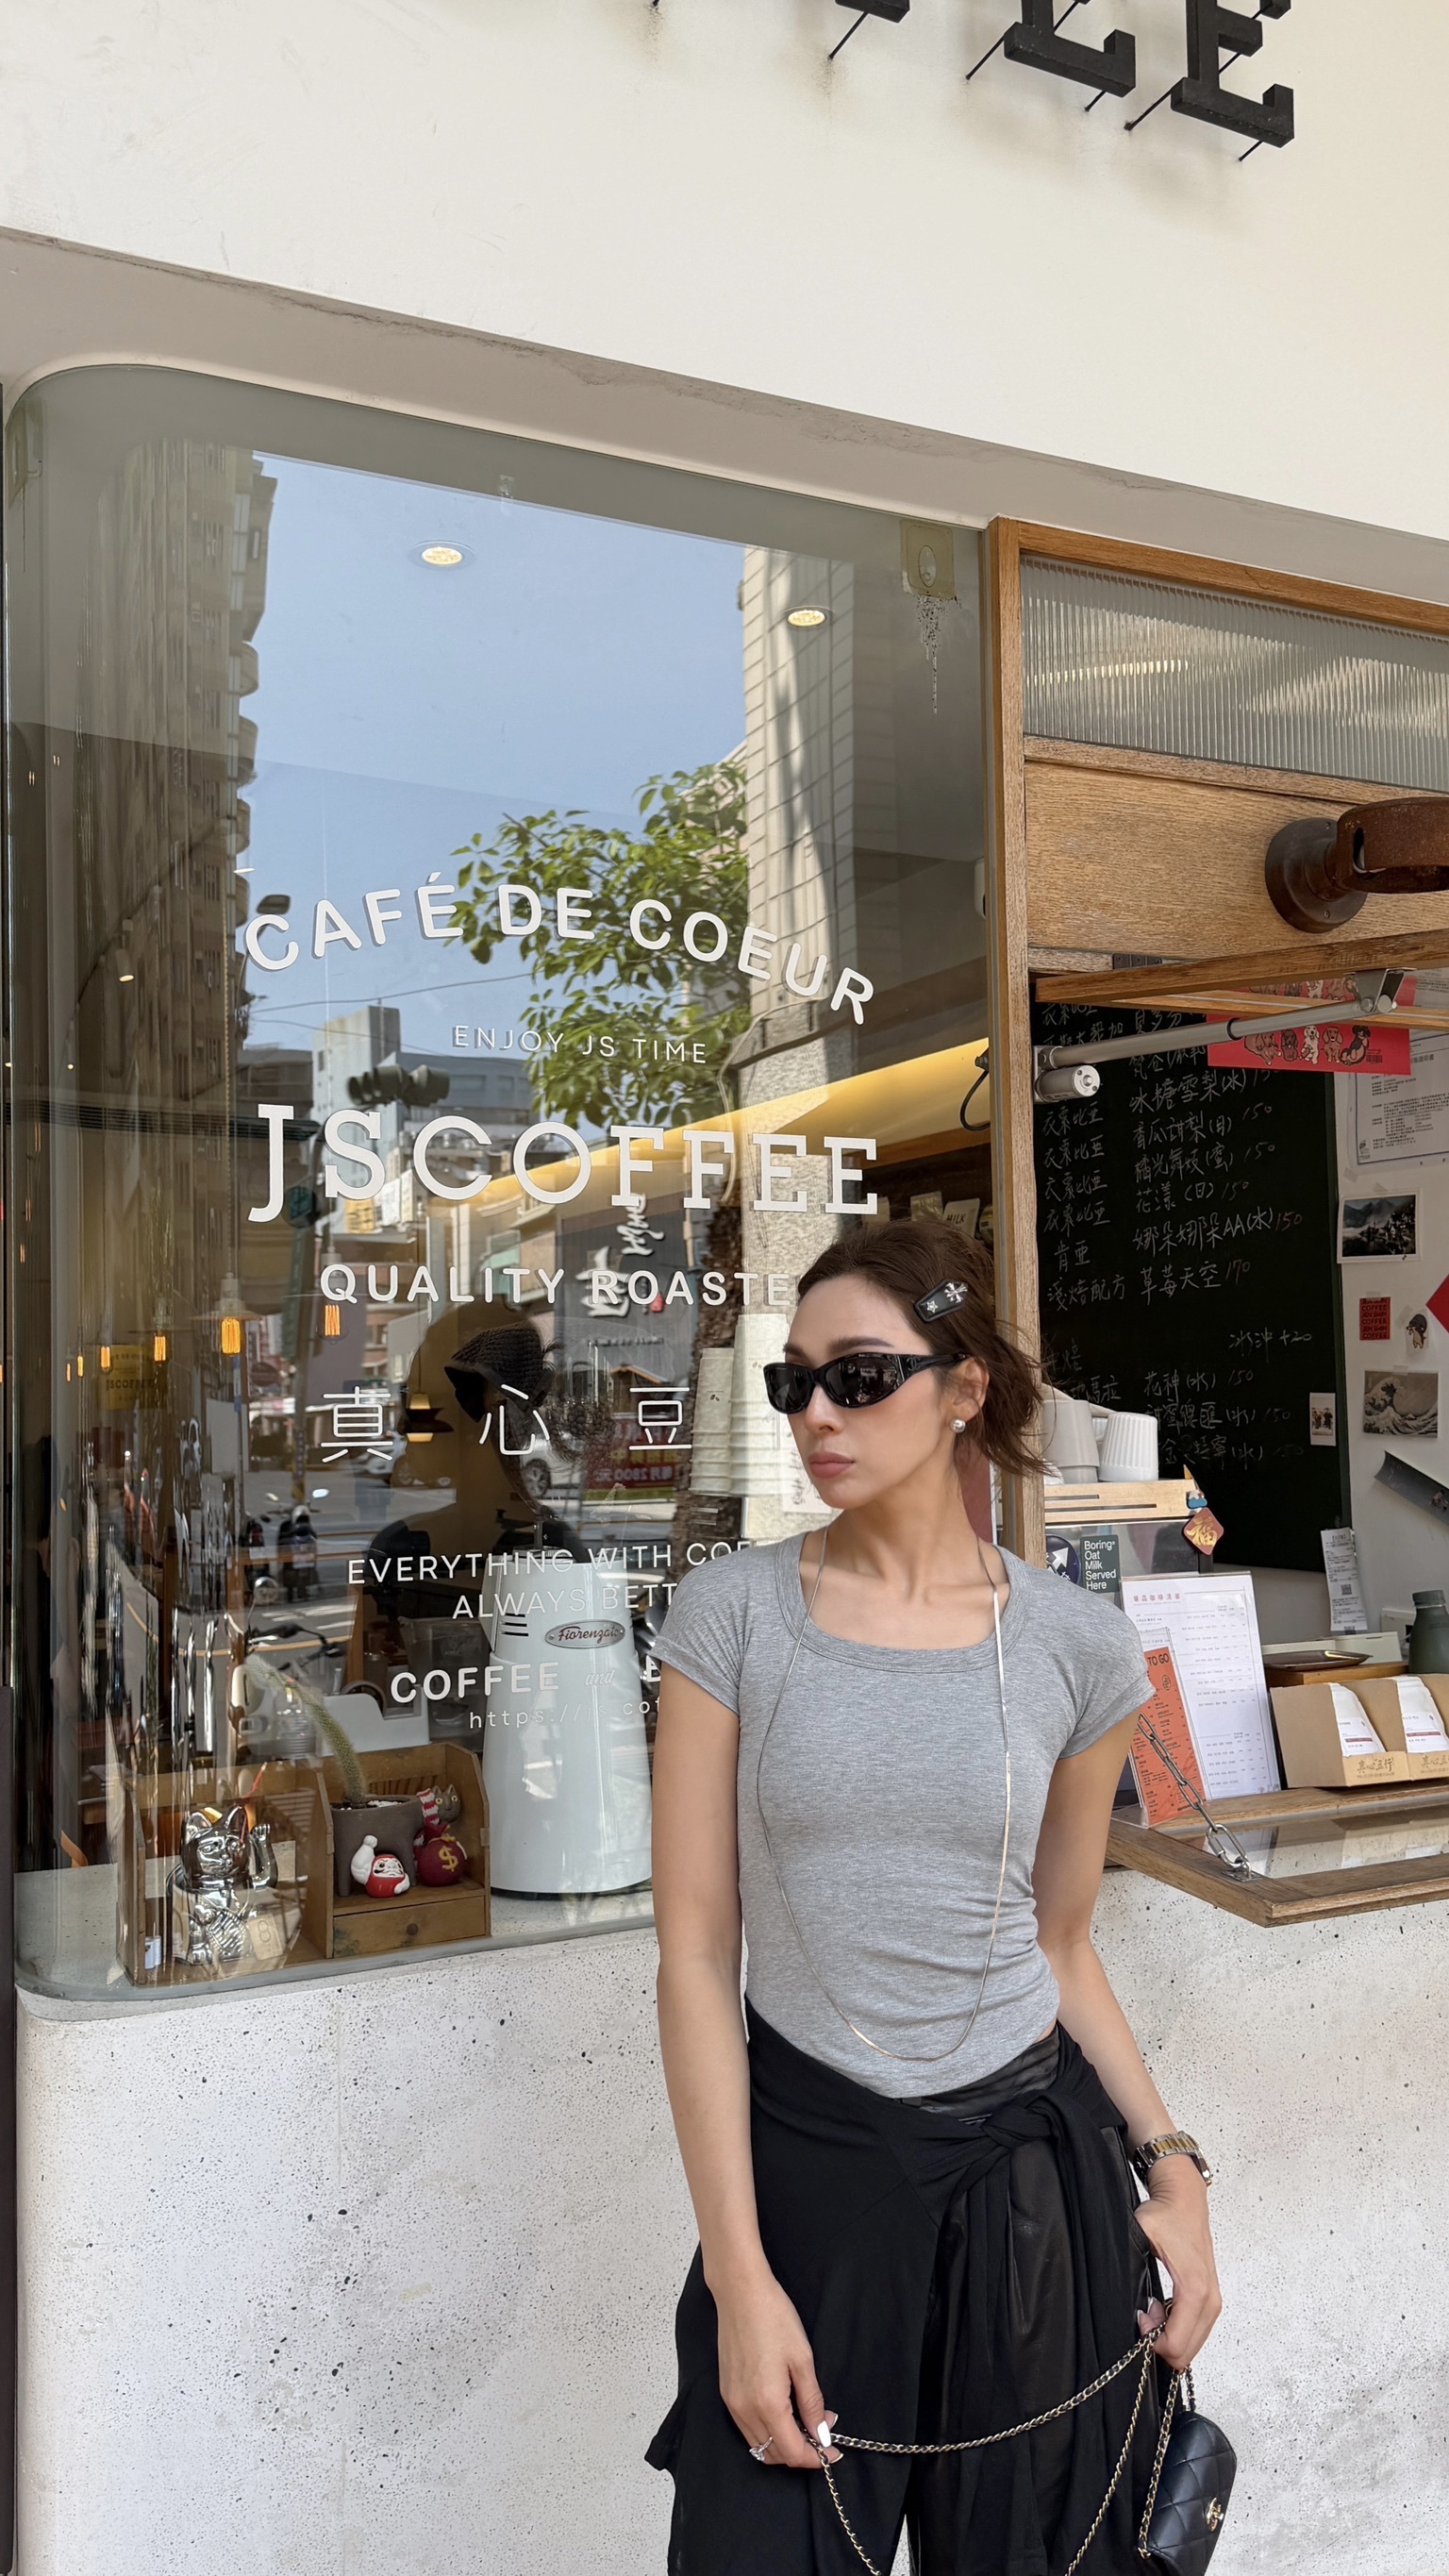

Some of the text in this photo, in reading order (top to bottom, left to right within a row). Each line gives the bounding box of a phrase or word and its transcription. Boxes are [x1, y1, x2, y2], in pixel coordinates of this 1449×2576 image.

[245, 872, 875, 1026] CAFÉ DE COEUR
[455, 1025, 708, 1064] ENJOY JS TIME
[1242, 1102, 1274, 1121] 150
[1244, 1142, 1275, 1163] 150
[248, 1103, 878, 1224] JSCOFFEE
[1222, 1180, 1249, 1201] 150
[946, 1213, 966, 1226] MILK
[1275, 1212, 1303, 1232] 150
[321, 1263, 565, 1308] QUALITY
[1140, 1260, 1223, 1306] 草莓天空
[1225, 1259, 1252, 1285] 170
[1228, 1370, 1254, 1386] 150
[1187, 1516, 1219, 1547] 福
[347, 1548, 575, 1585] EVERYTHING
[589, 1544, 672, 1570] WITH
[1084, 1550, 1100, 1561] Oat
[1085, 1560, 1103, 1570] Milk
[1085, 1569, 1117, 1581] Served
[1086, 1581, 1108, 1591] Here
[452, 1588, 587, 1620] ALWAYS
[1147, 1652, 1171, 1667] TO GO
[390, 1661, 559, 1702] COFFEE
[584, 1668, 615, 1687] and
[1421, 1754, 1449, 1769] 真心豆
